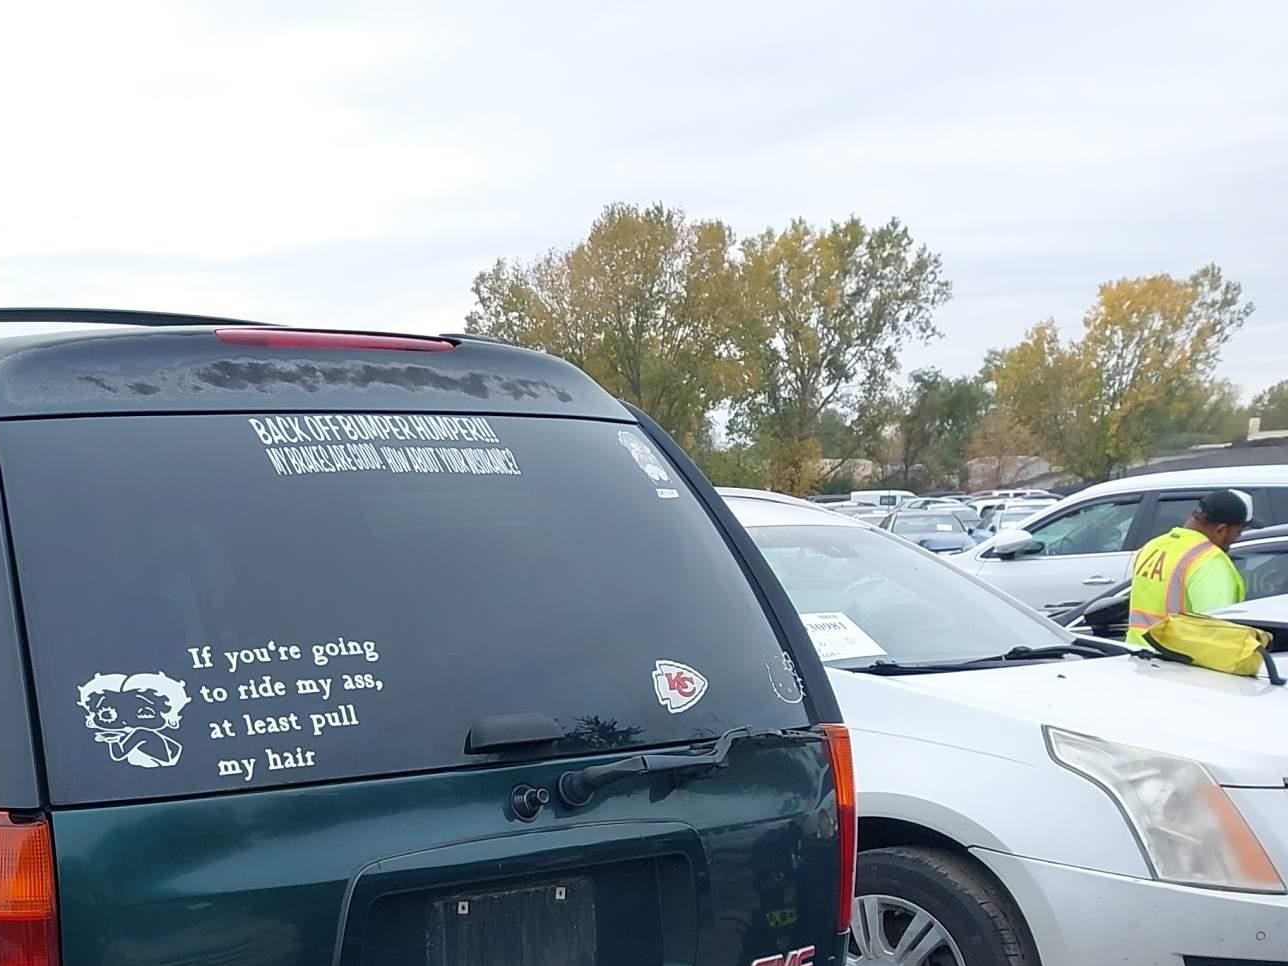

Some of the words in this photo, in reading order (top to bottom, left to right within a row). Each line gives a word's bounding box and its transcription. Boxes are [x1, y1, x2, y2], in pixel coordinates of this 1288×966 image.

[248, 415, 312, 445] BACK
[303, 415, 342, 441] OFF
[334, 415, 418, 440] BUMPER
[407, 415, 500, 443] HUMPER!!!
[265, 447, 293, 475] MY
[283, 445, 336, 475] BRAKES
[326, 444, 357, 472] ARE
[379, 446, 412, 473] HOW
[405, 446, 445, 474] ABOUT
[434, 446, 472, 474] YOUR
[187, 646, 214, 669] If
[223, 640, 302, 673] you're
[312, 637, 380, 666] going
[200, 684, 228, 703] to
[238, 675, 287, 700] ride
[296, 676, 333, 700] my
[342, 673, 384, 691] ass,
[664, 671, 697, 698] KC
[209, 719, 236, 739] at
[243, 713, 302, 736] least
[310, 704, 360, 736] pull
[218, 757, 256, 781] my
[264, 746, 316, 770] hair
